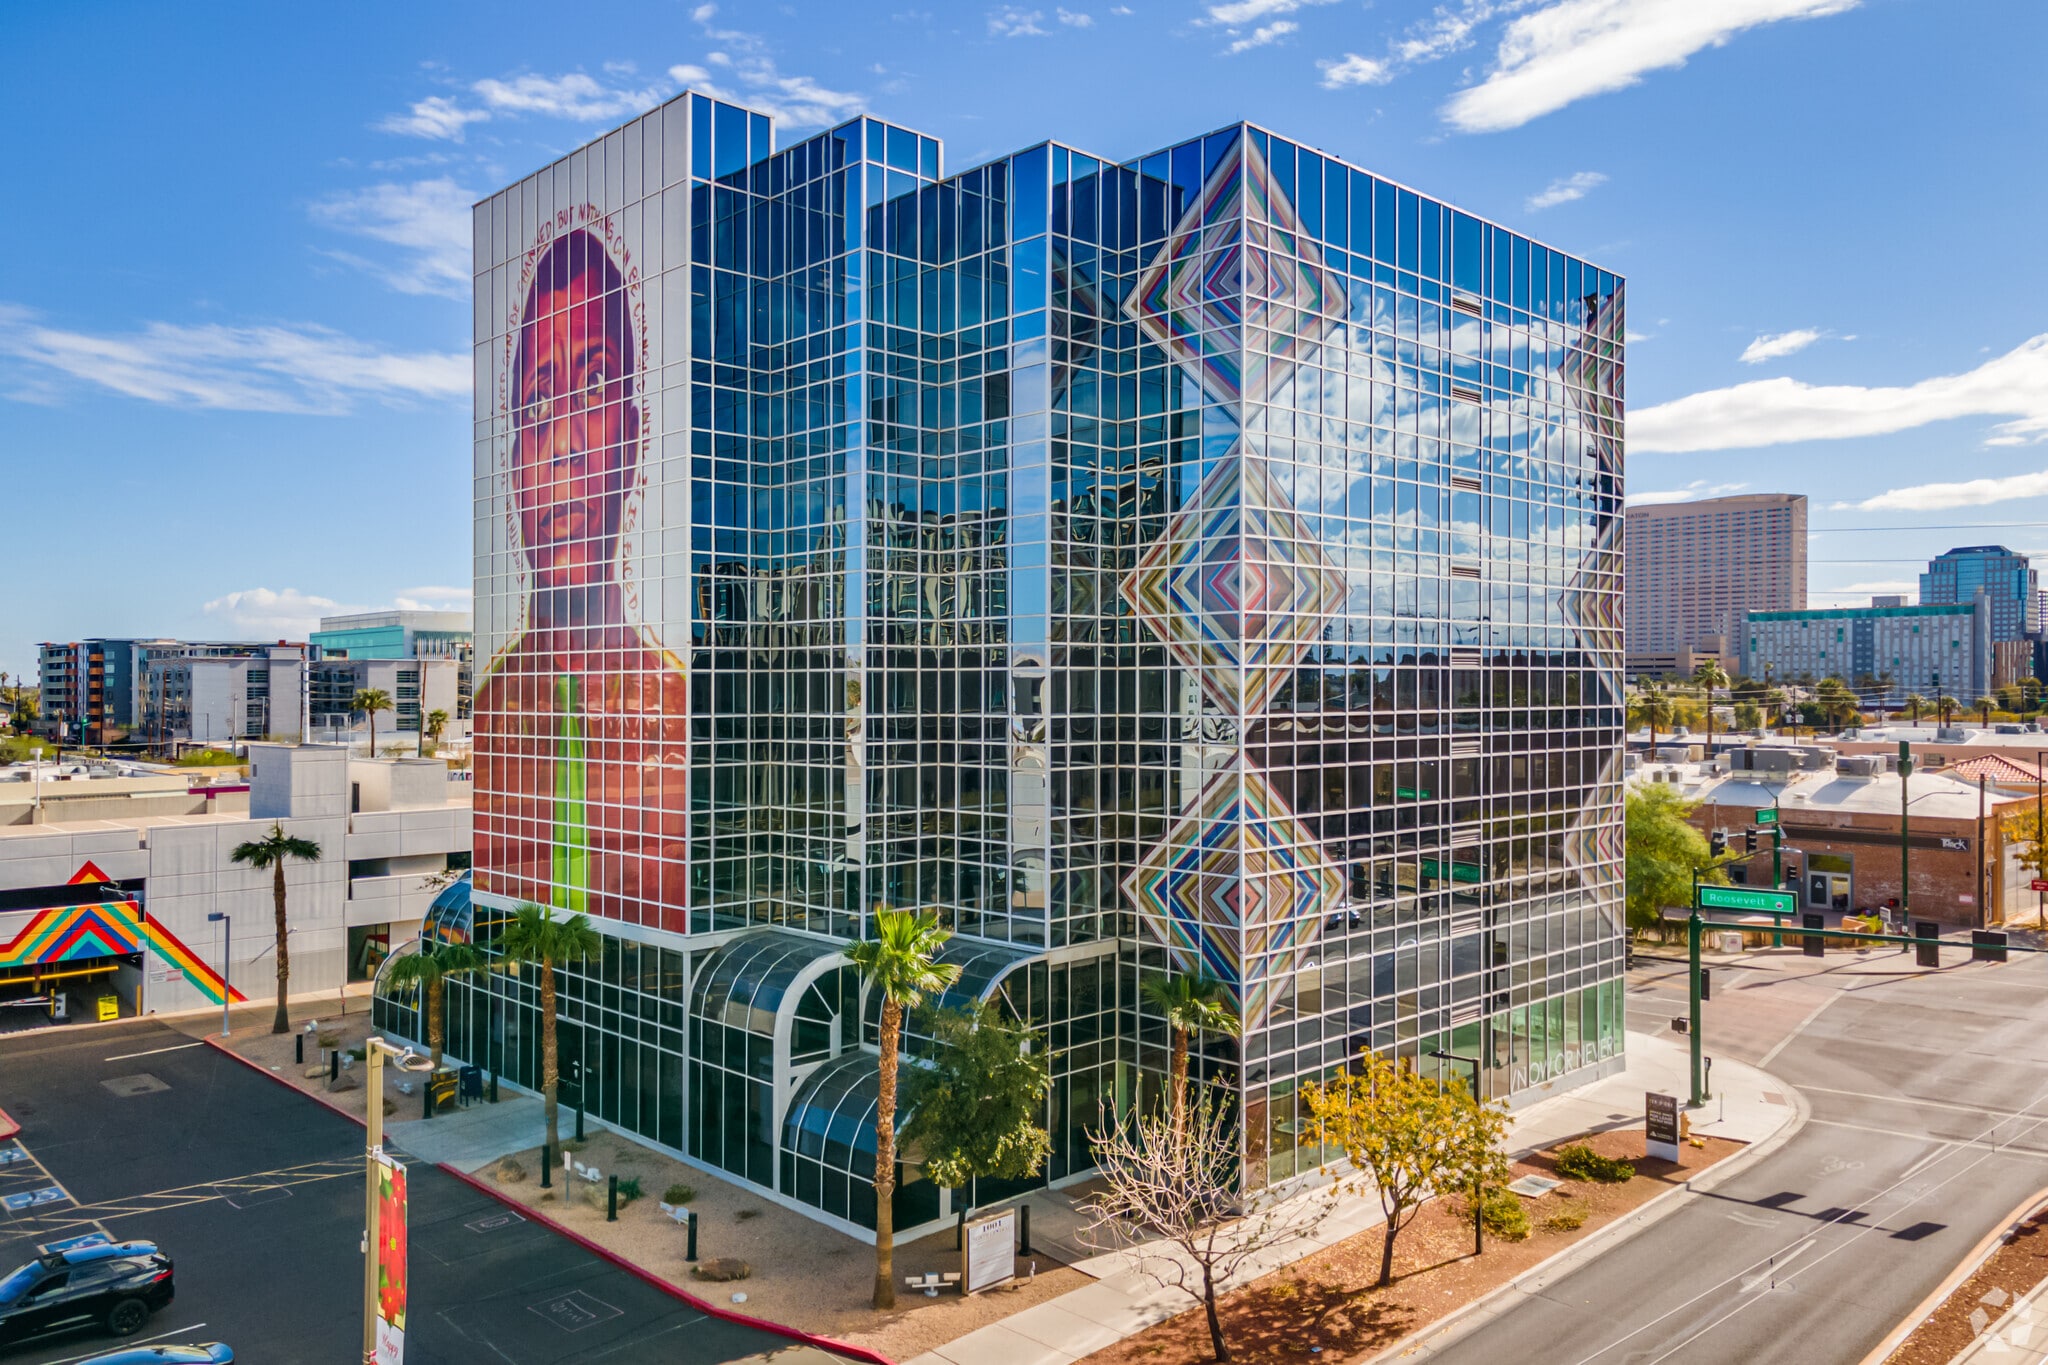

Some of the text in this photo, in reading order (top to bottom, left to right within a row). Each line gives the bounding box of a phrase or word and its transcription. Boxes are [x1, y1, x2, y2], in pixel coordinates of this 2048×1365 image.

[556, 205, 575, 230] BUT
[578, 200, 615, 244] NOTHING
[628, 265, 642, 298] BE
[509, 299, 520, 327] BE
[624, 501, 638, 534] IS
[1709, 892, 1765, 906] Roosevelt
[1576, 1036, 1614, 1070] NEVER
[983, 1219, 1002, 1233] 1001
[382, 1332, 399, 1359] Happy
